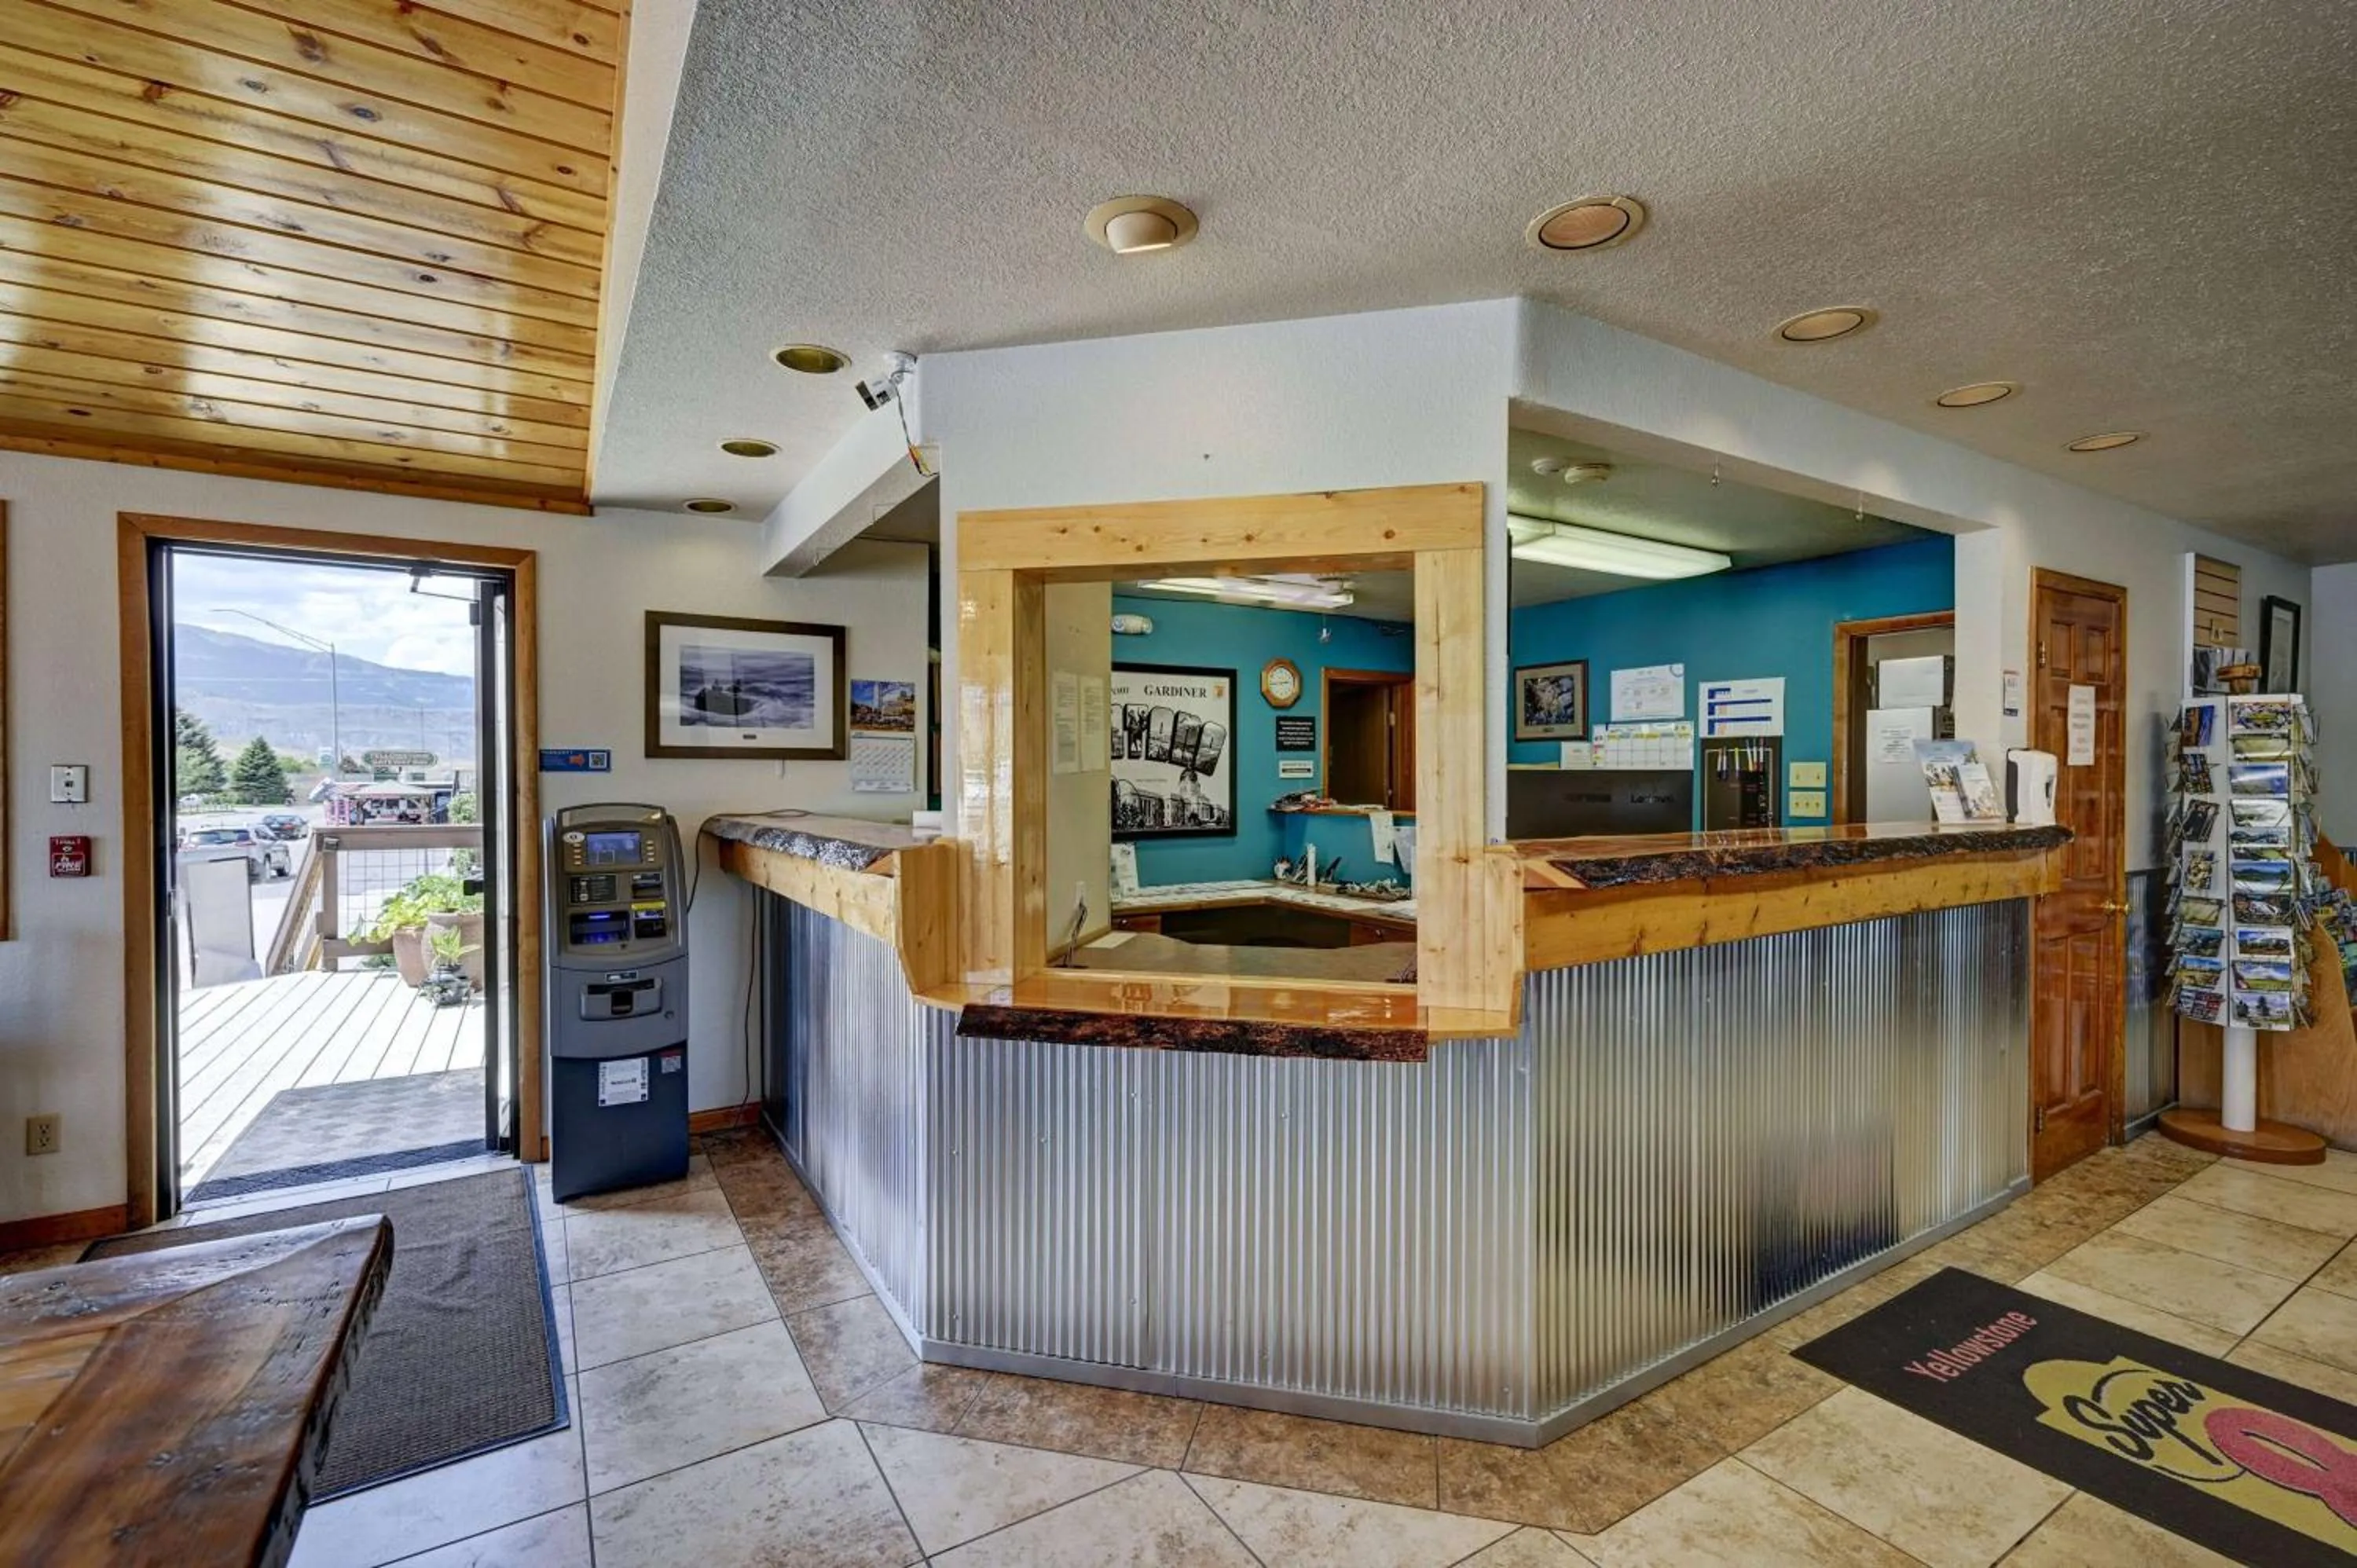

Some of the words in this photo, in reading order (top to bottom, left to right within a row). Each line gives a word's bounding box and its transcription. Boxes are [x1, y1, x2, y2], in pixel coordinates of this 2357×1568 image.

[1144, 684, 1208, 698] GARDINER
[1903, 1310, 2037, 1383] Yellowstone
[2062, 1378, 2224, 1466] Super
